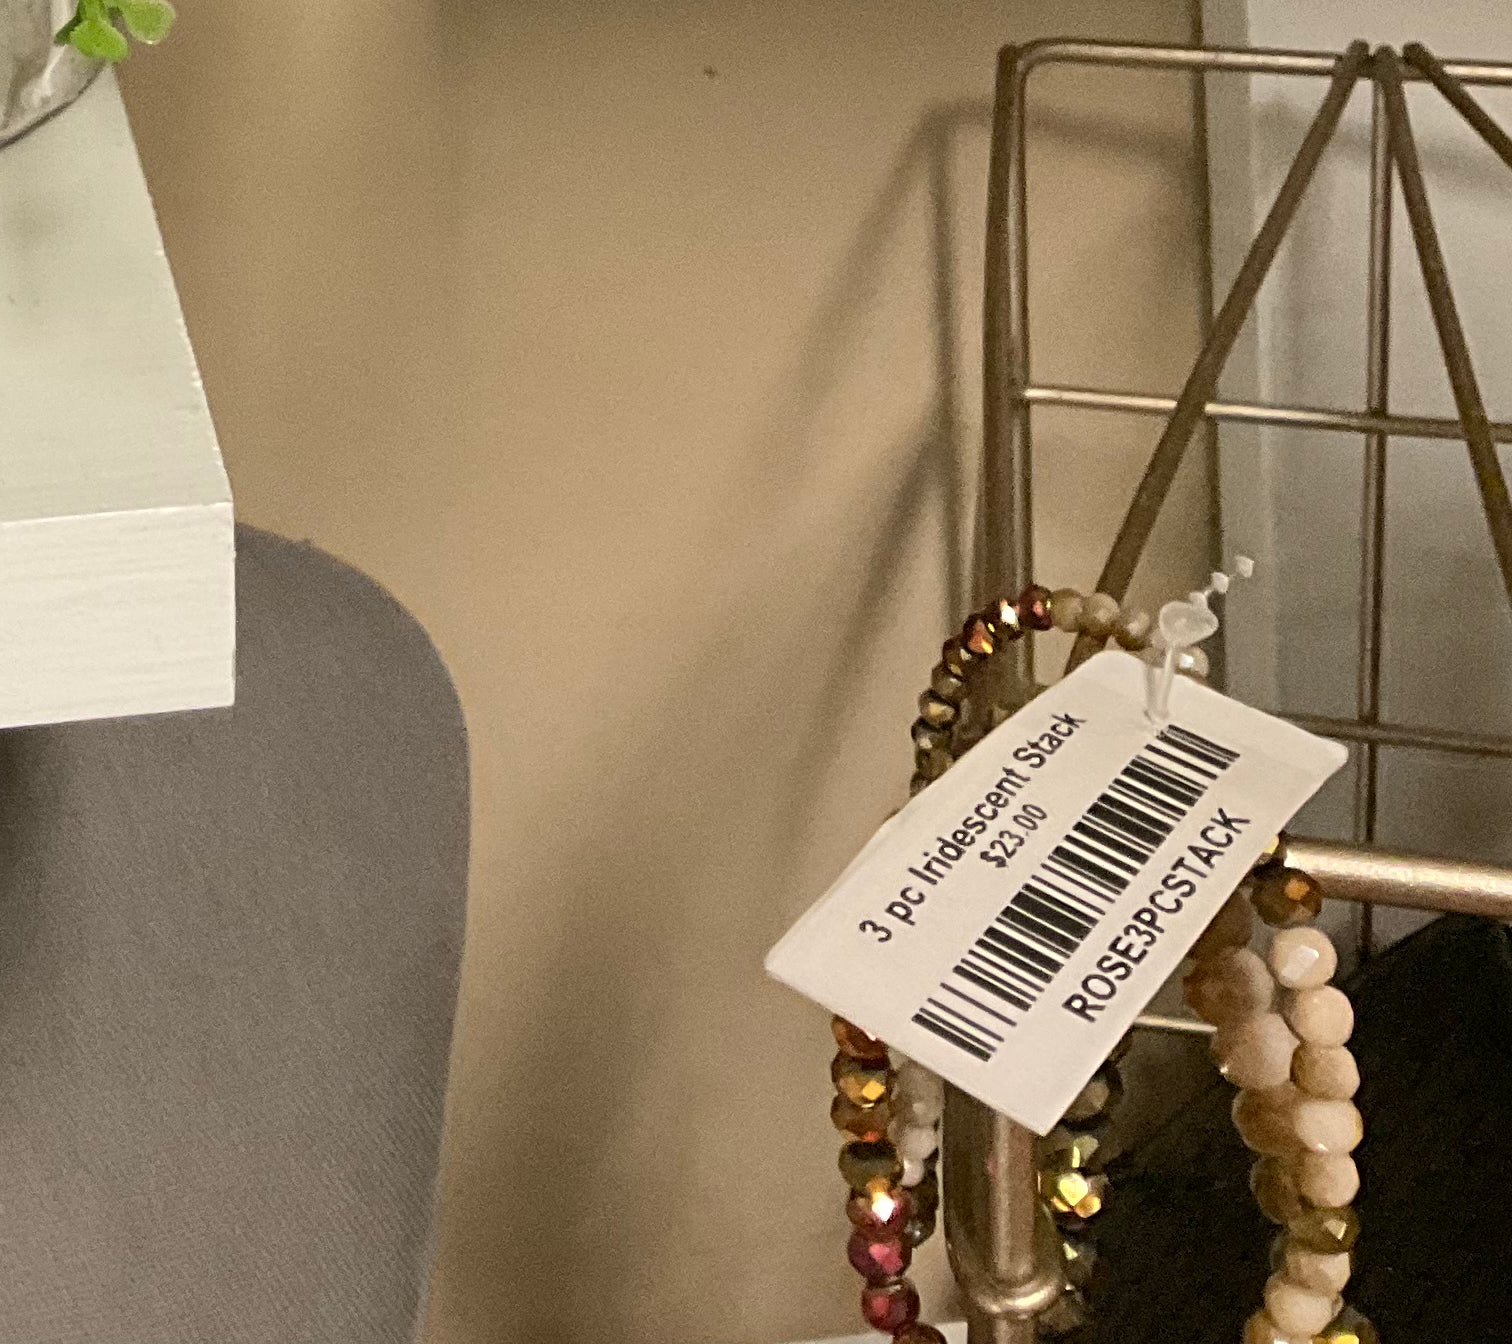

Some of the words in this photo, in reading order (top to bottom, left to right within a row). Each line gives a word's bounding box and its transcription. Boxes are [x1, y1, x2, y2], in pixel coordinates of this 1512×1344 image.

[859, 918, 893, 944] 3
[884, 885, 926, 926] pc
[907, 766, 1031, 886] Iridescent
[1012, 712, 1088, 769] Stack
[979, 803, 1048, 868] $23.00
[1061, 807, 1252, 1024] ROSE3PCSTACK
